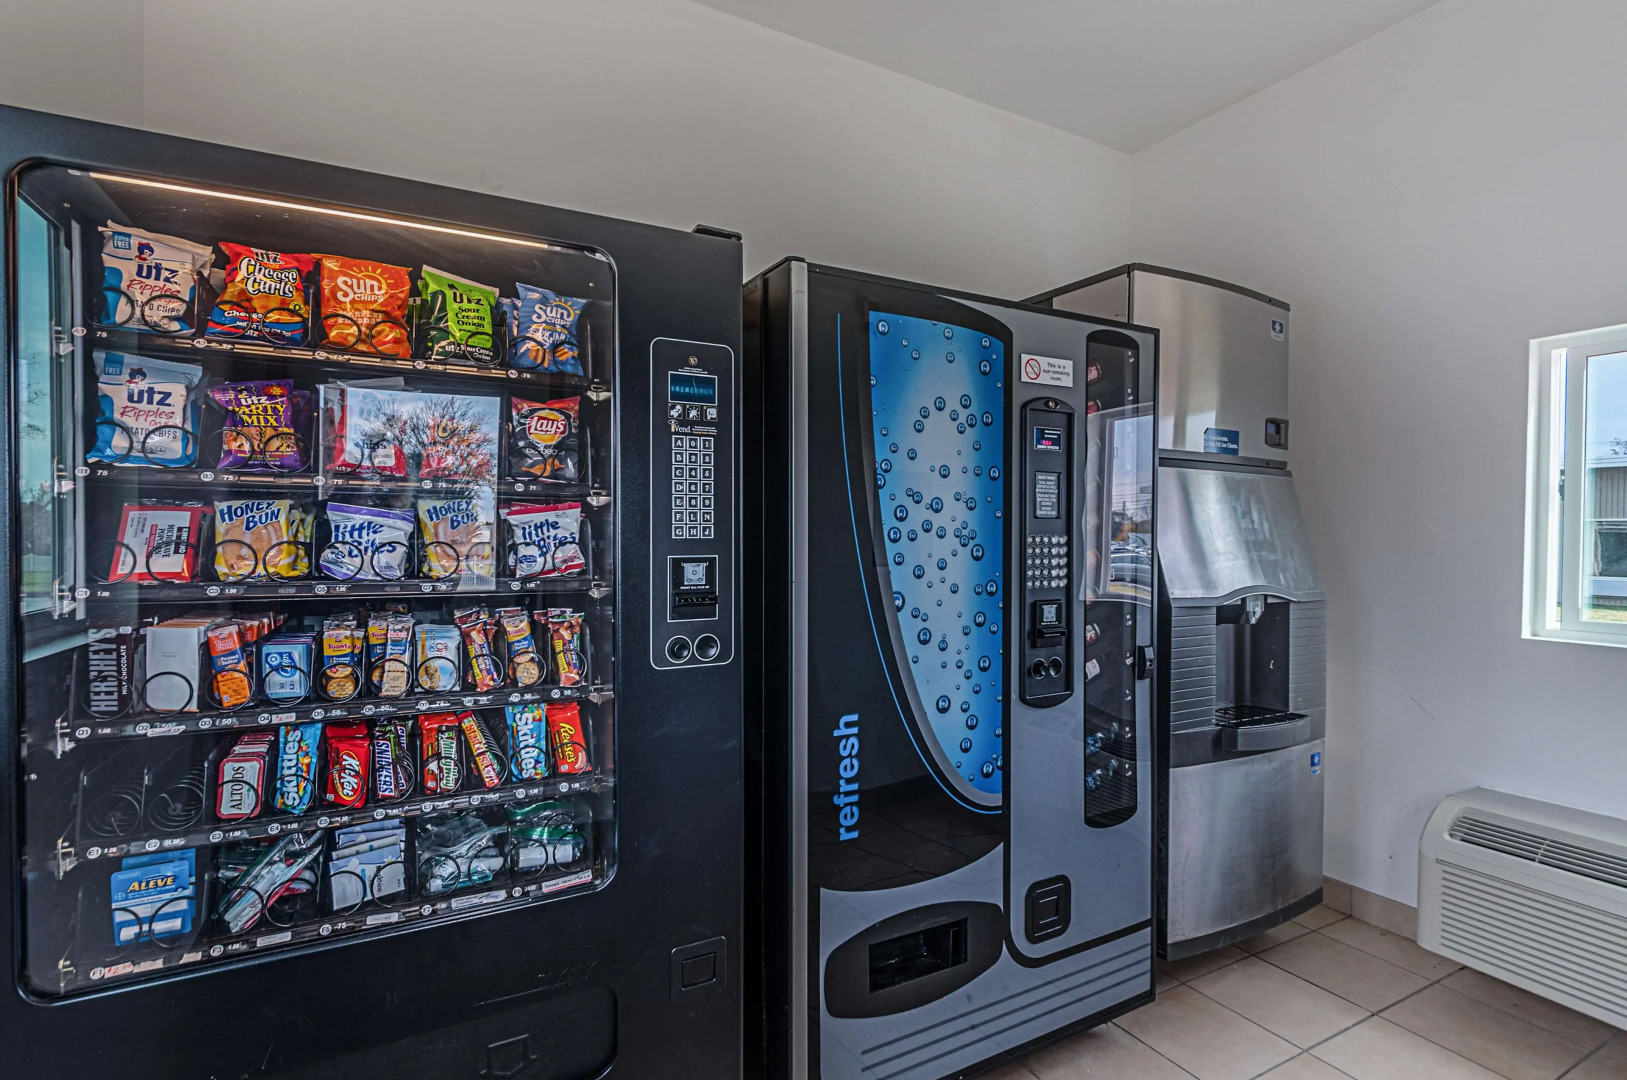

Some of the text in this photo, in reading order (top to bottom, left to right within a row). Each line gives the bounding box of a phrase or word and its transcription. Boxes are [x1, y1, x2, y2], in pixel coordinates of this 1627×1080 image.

[114, 241, 130, 249] FREE
[136, 263, 180, 285] utz
[240, 257, 297, 284] Cheese
[126, 279, 181, 296] Ripples
[246, 276, 294, 298] Curls
[336, 276, 386, 302] Sun
[354, 294, 384, 302] CHIPS
[456, 312, 485, 321] Cream
[458, 306, 480, 314] Sour
[532, 304, 574, 322] Sun
[457, 320, 485, 328] Onion
[546, 318, 571, 328] CHIPS
[1042, 369, 1070, 377] non-smoking
[127, 386, 173, 406] utz
[240, 396, 268, 406] utz
[120, 405, 176, 422] Ripples
[230, 404, 286, 415] ARTY
[241, 414, 279, 427] MIX
[154, 430, 178, 440] CHIPS
[218, 501, 276, 524] HONEY
[426, 500, 472, 522] HONEY
[244, 508, 282, 532] BUN
[221, 654, 239, 662] Peanut
[222, 658, 238, 666] Butter
[440, 739, 456, 768] Mily
[515, 712, 538, 778] Skittles
[282, 730, 302, 806] Skittles
[376, 741, 394, 795] SNICKERS
[833, 713, 860, 841] refresh
[229, 766, 245, 810] ALTODS
[127, 876, 175, 893] ALEVE
